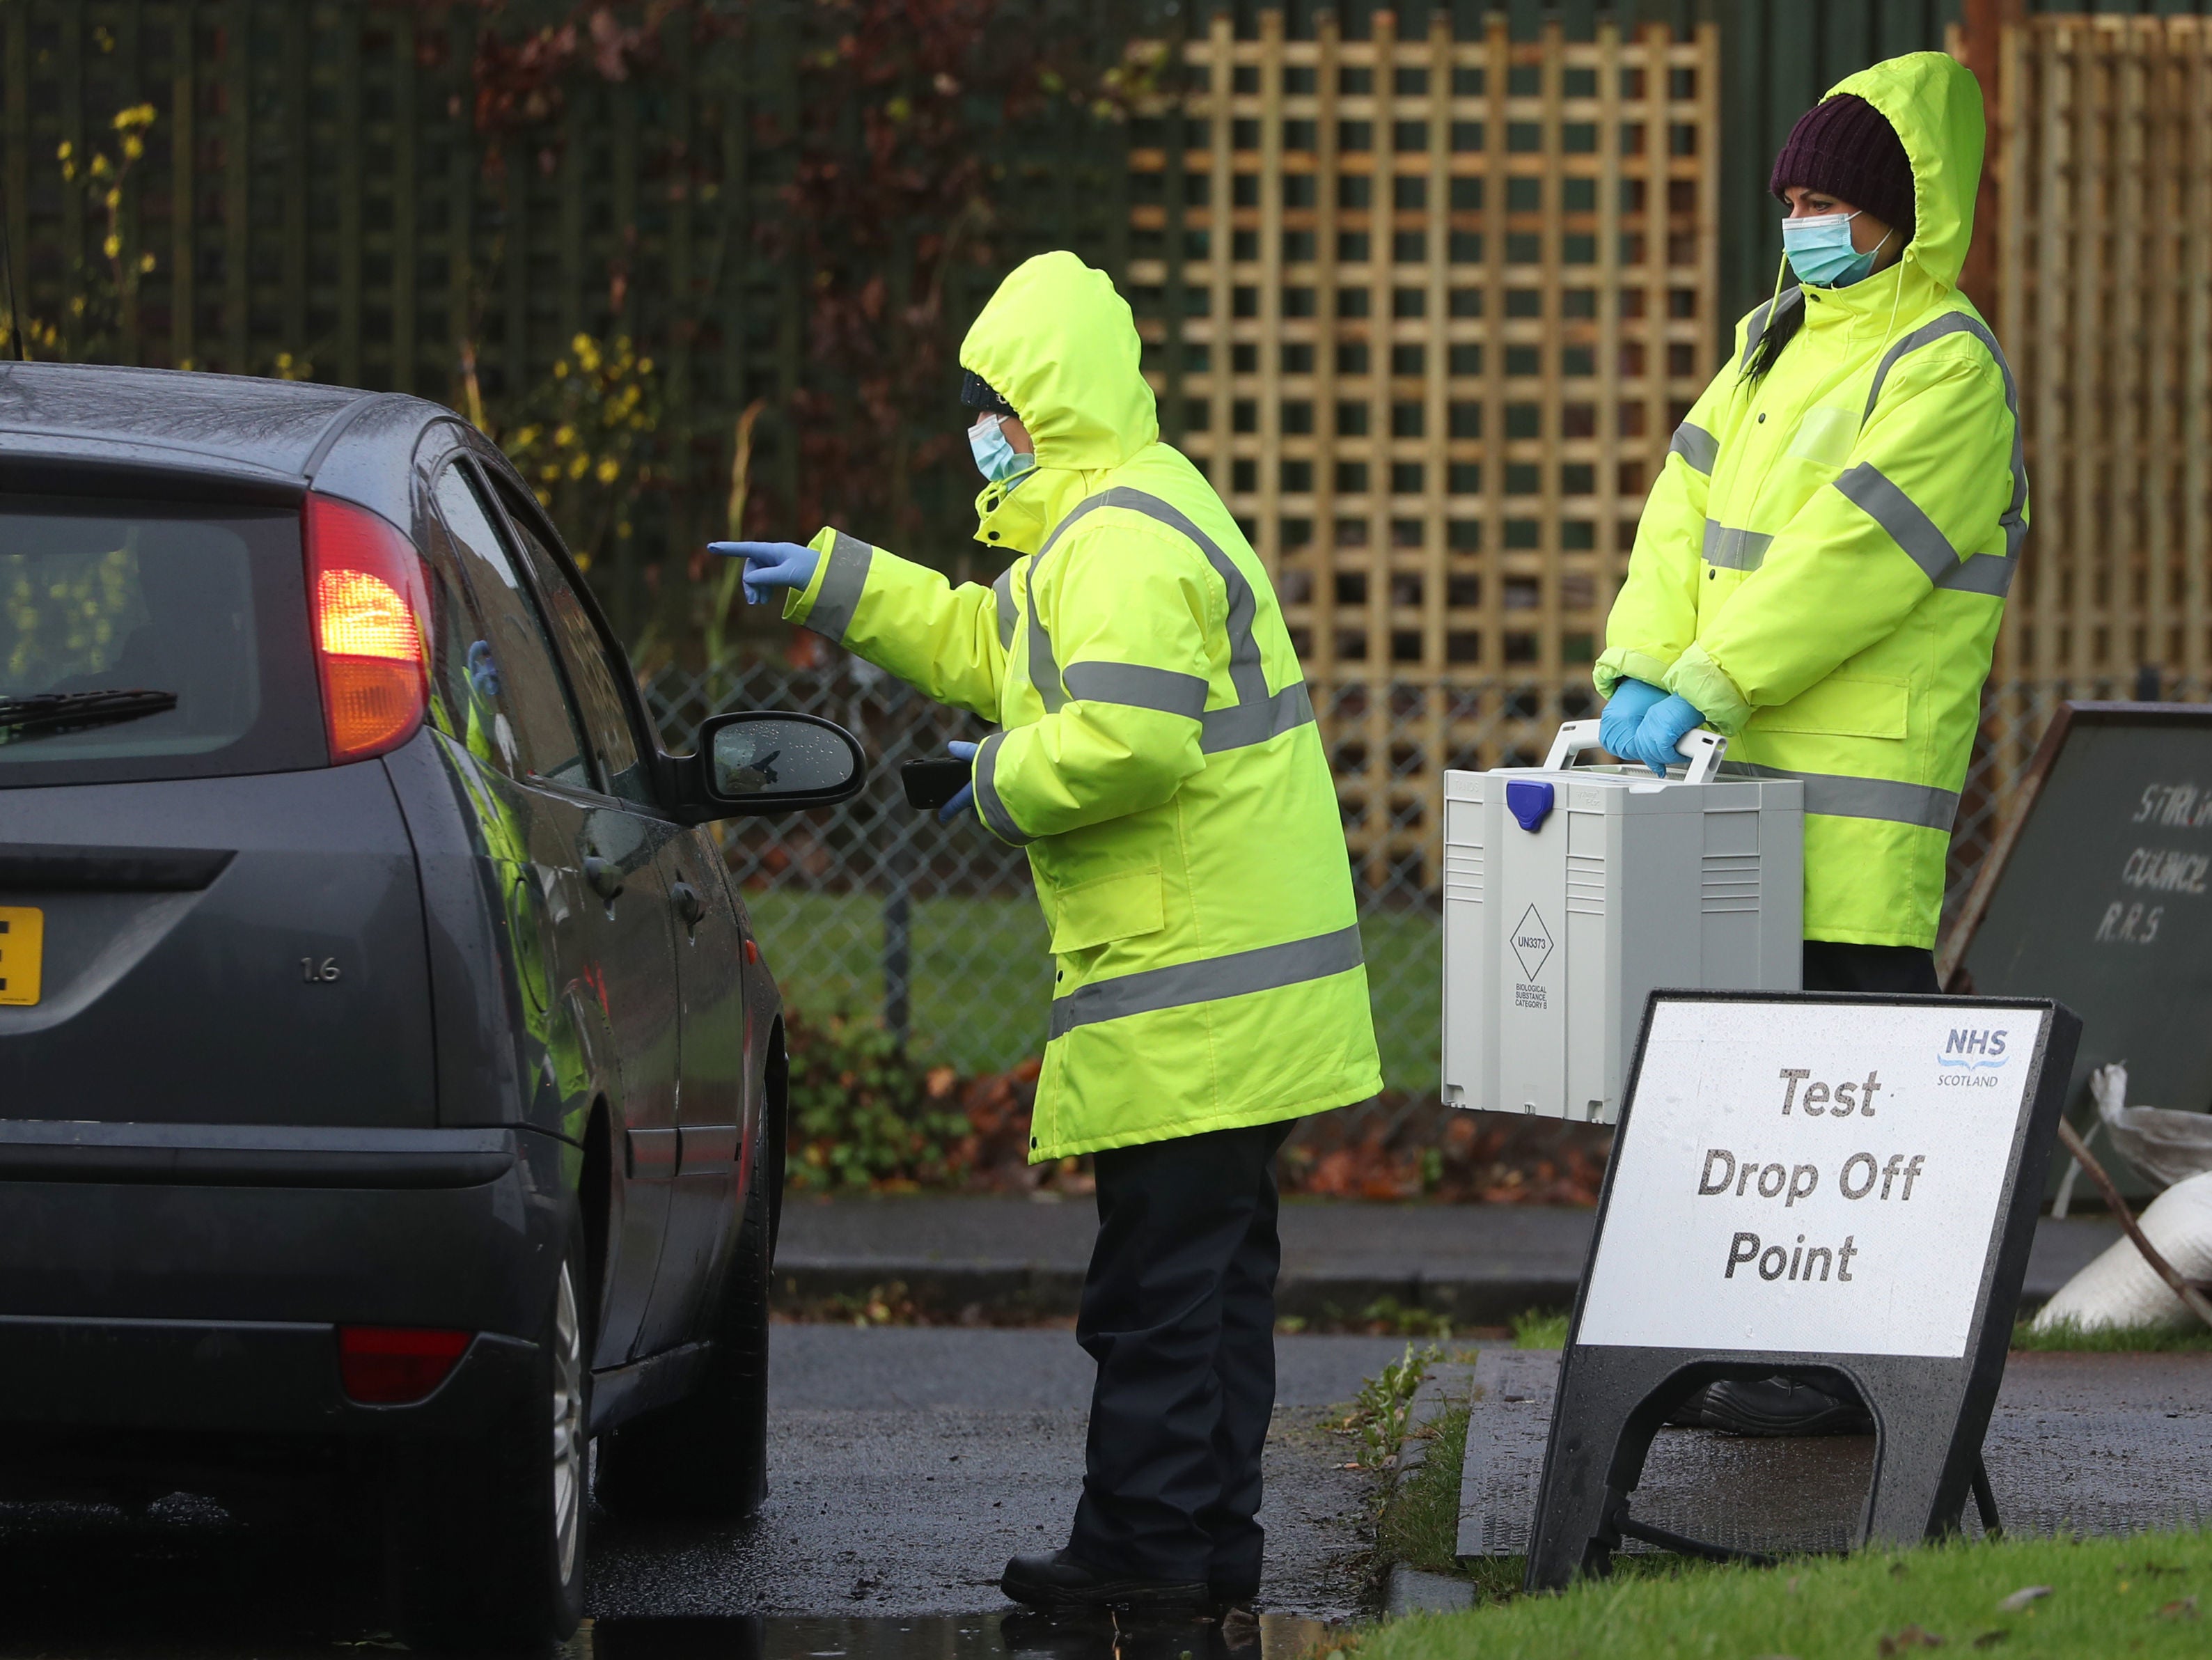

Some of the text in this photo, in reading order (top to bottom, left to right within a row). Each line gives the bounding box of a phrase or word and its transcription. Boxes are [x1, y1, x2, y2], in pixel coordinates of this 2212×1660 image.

[1518, 936, 1546, 949] UN3373
[300, 957, 340, 982] 1.6
[1516, 983, 1547, 994] BIOLOGICAL
[1515, 999, 1547, 1010] CATEGORY B
[1945, 1029, 2008, 1055] NHS
[1779, 1068, 1881, 1117] Test
[1937, 1074, 1998, 1087] SCOTLAND
[1697, 1149, 1926, 1207] Drop Off
[1724, 1232, 1858, 1281] Point
